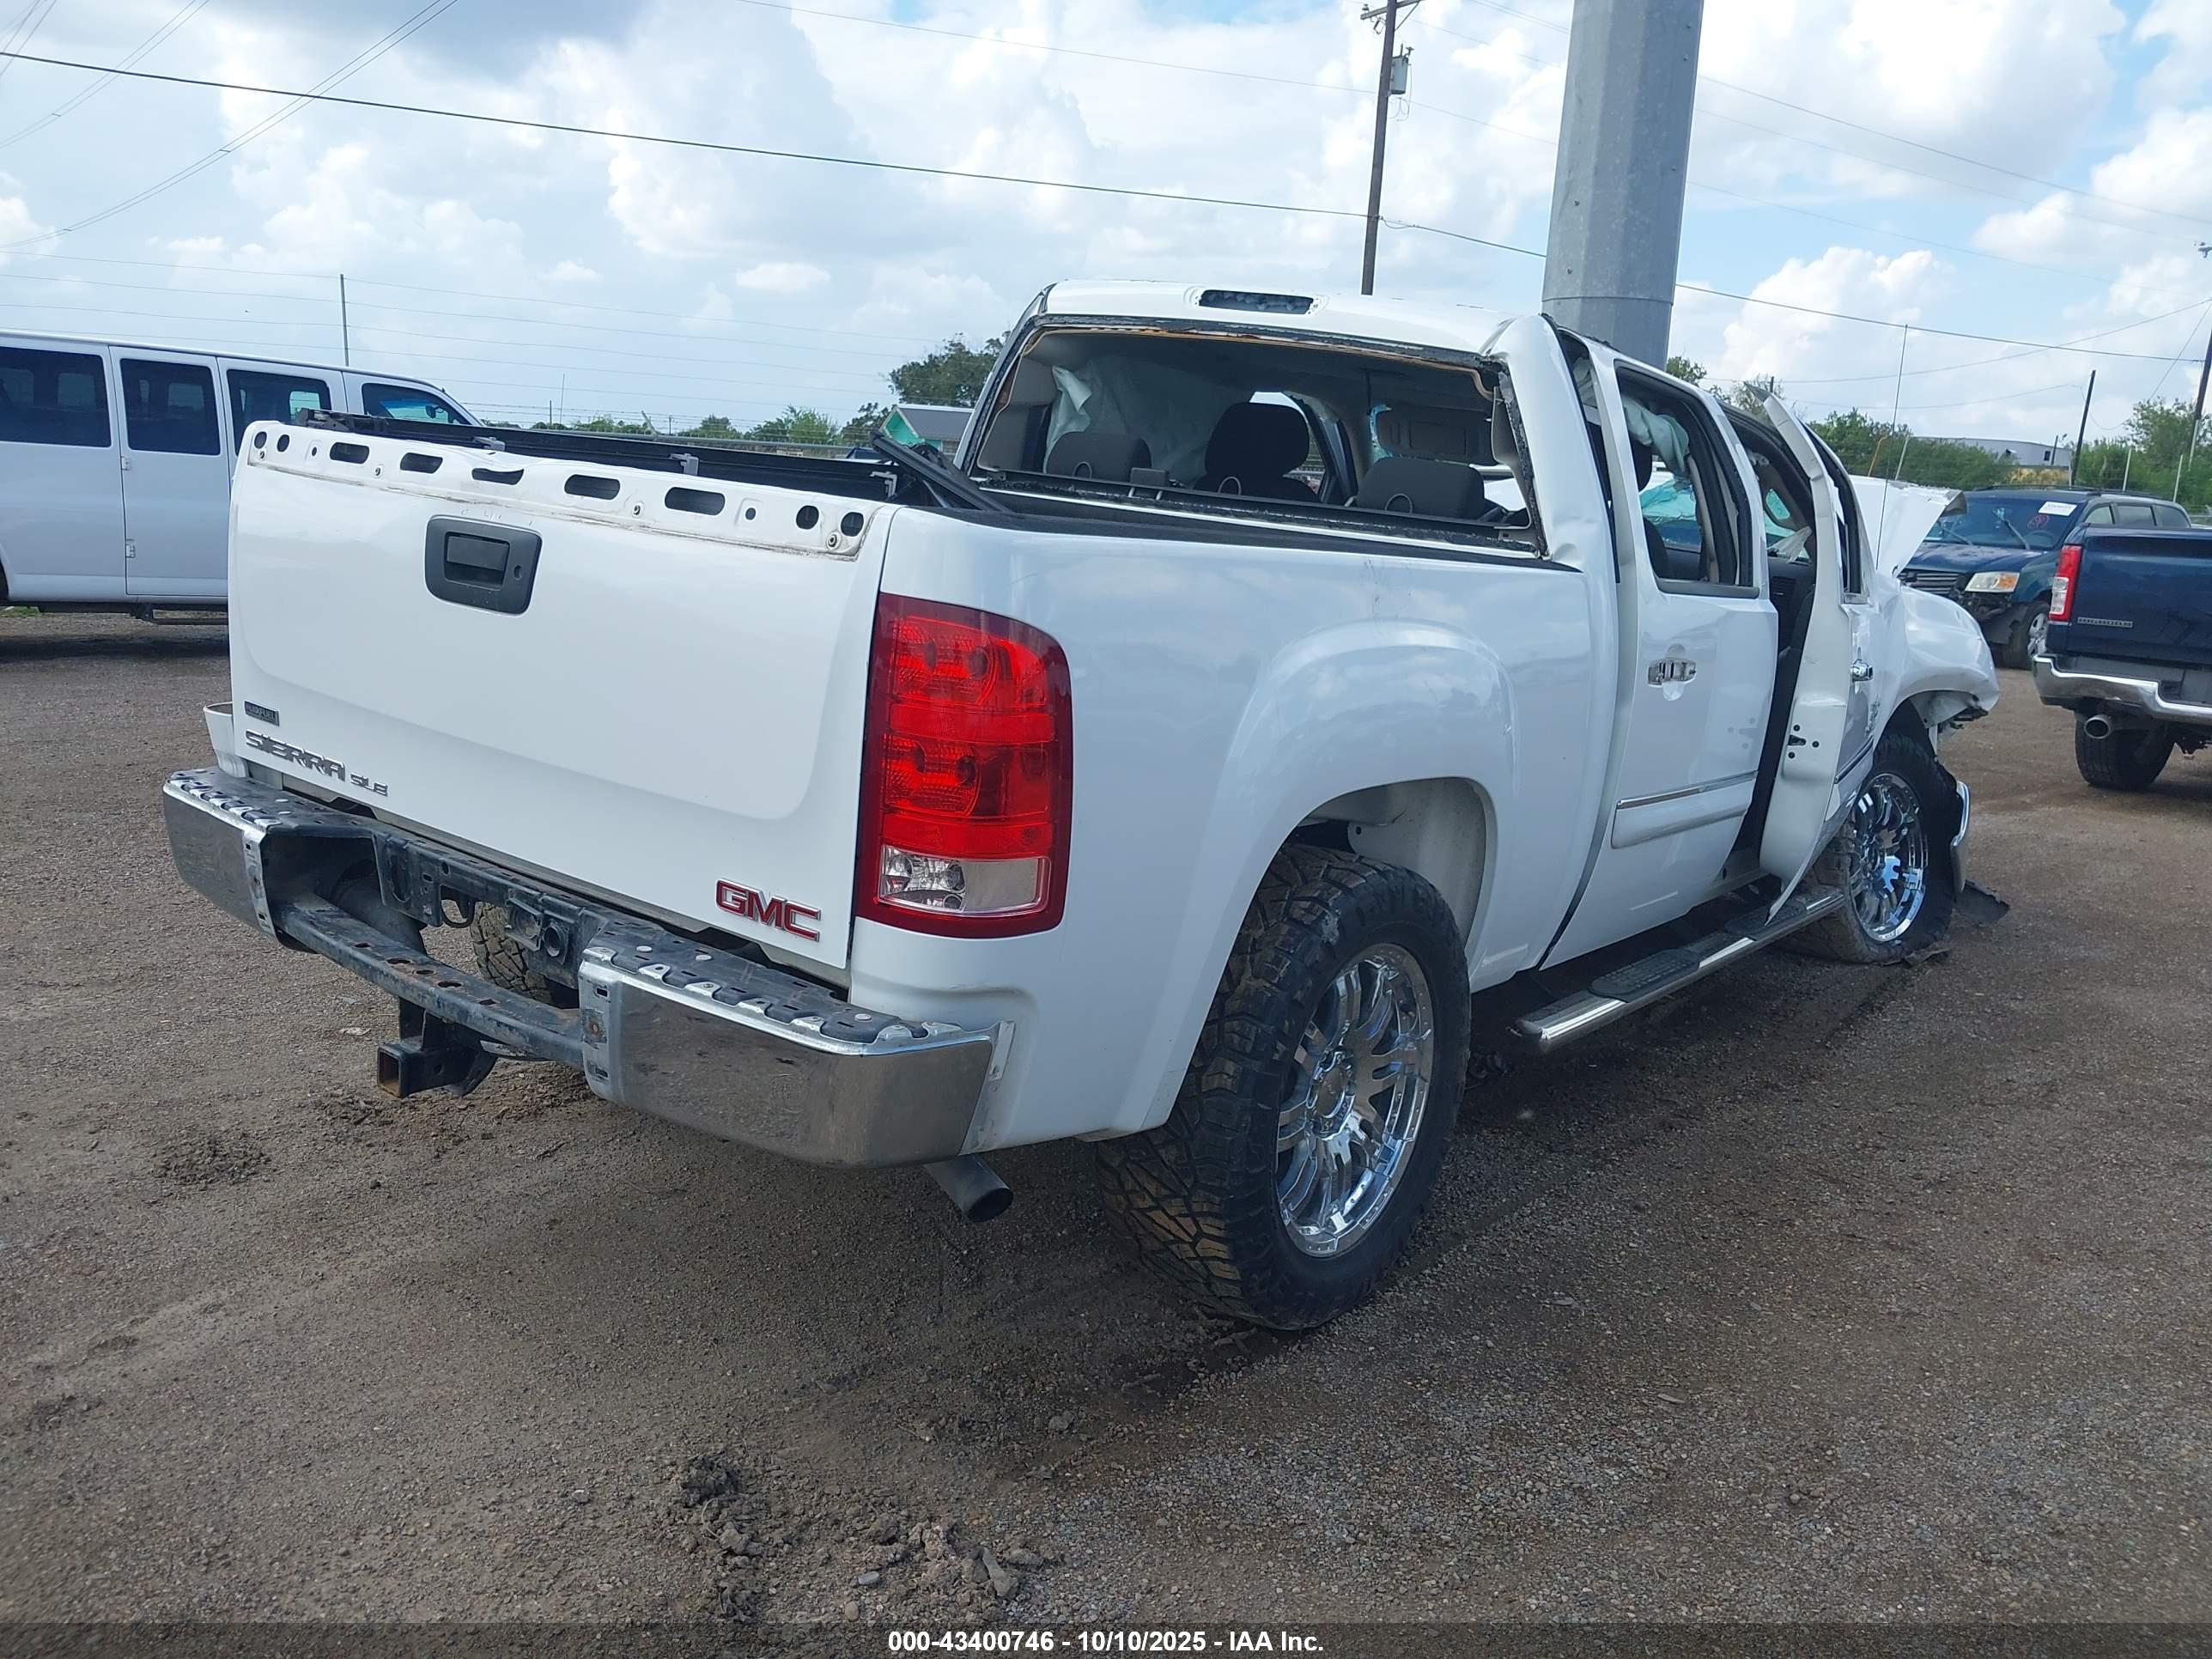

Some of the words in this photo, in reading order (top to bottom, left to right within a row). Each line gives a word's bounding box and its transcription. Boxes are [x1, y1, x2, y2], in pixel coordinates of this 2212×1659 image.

[246, 729, 346, 782] SIERRA
[349, 772, 388, 797] SLE
[715, 878, 822, 943] GMC
